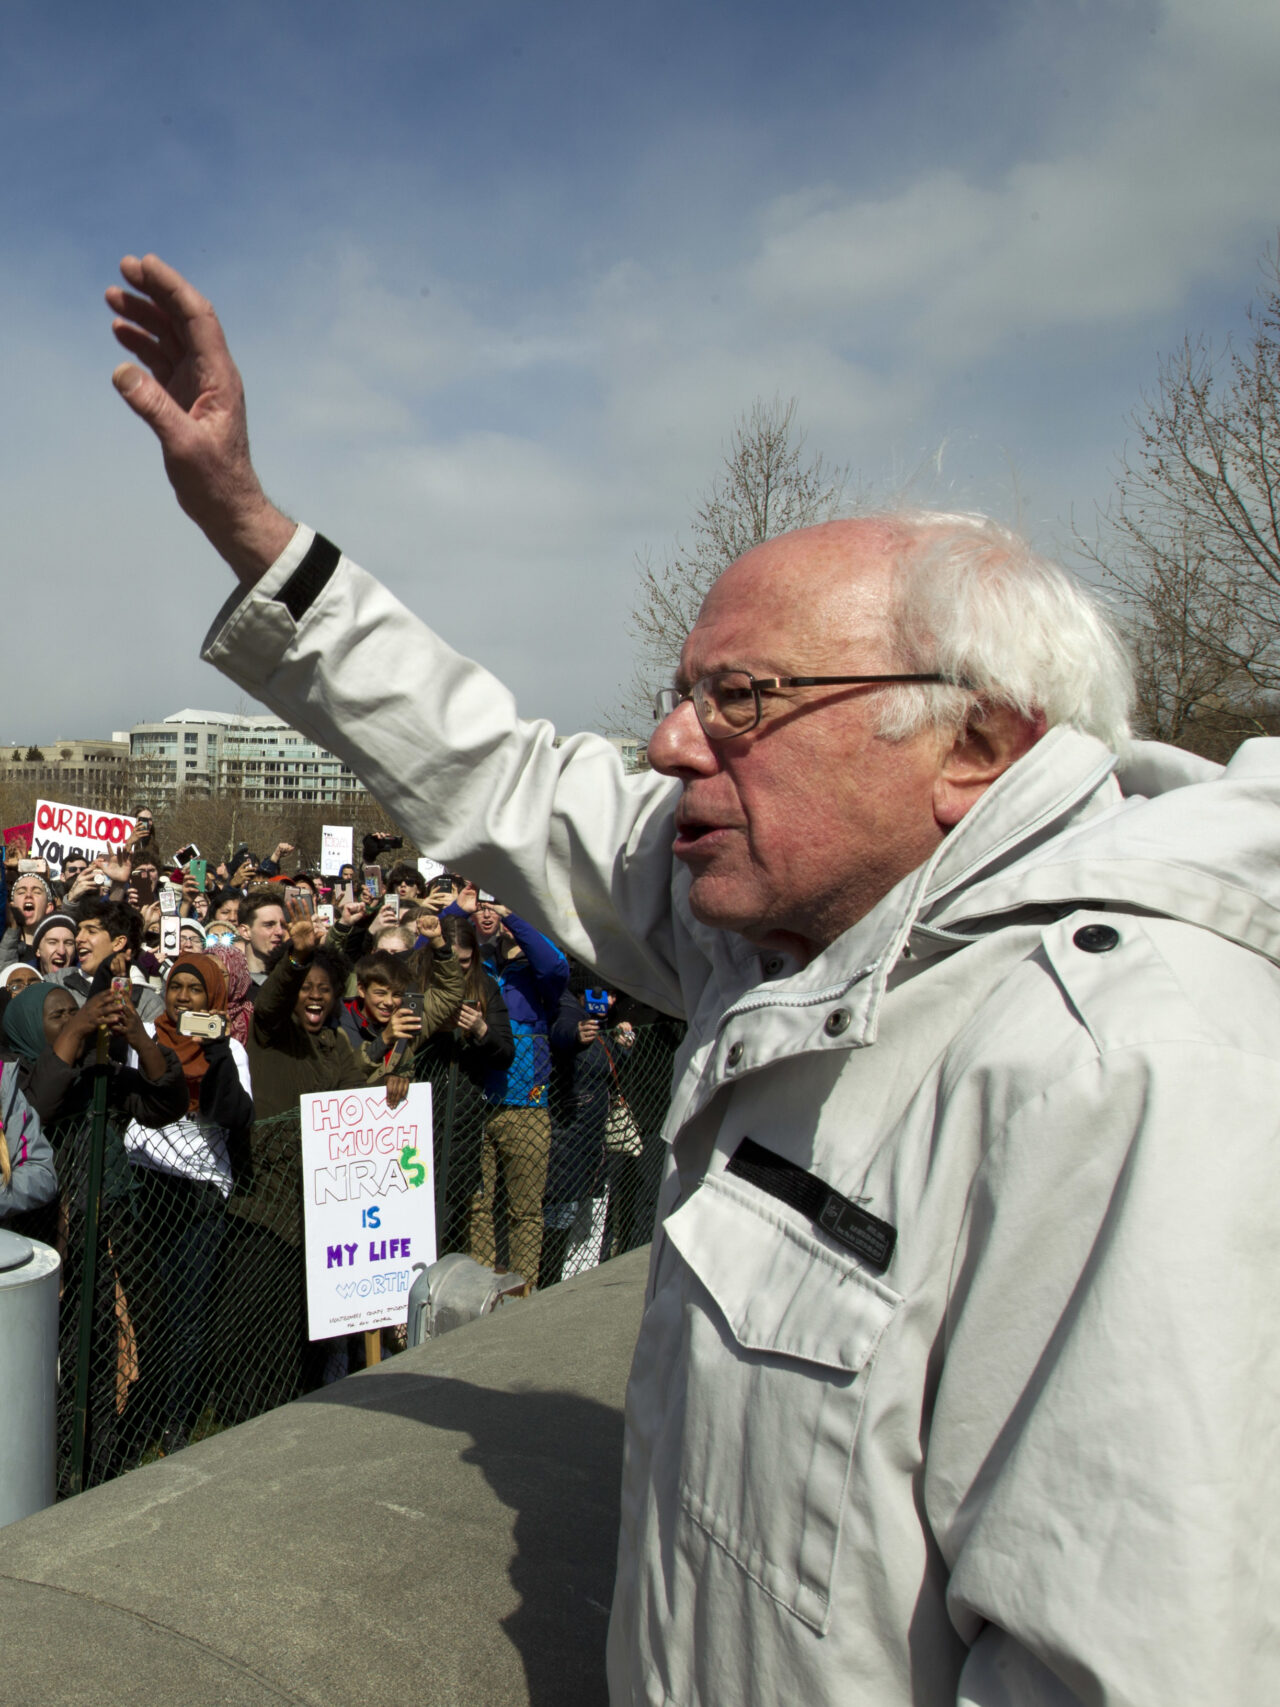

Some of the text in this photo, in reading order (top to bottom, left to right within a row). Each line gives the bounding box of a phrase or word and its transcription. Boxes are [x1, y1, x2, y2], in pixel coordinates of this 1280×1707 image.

[37, 804, 73, 835] OUR
[75, 811, 134, 844] BLOOD
[588, 1003, 606, 1011] VOA
[312, 1096, 408, 1131] HOW
[329, 1125, 418, 1160] MUCH
[362, 1206, 381, 1228] IS
[327, 1238, 411, 1268] MY LIFE
